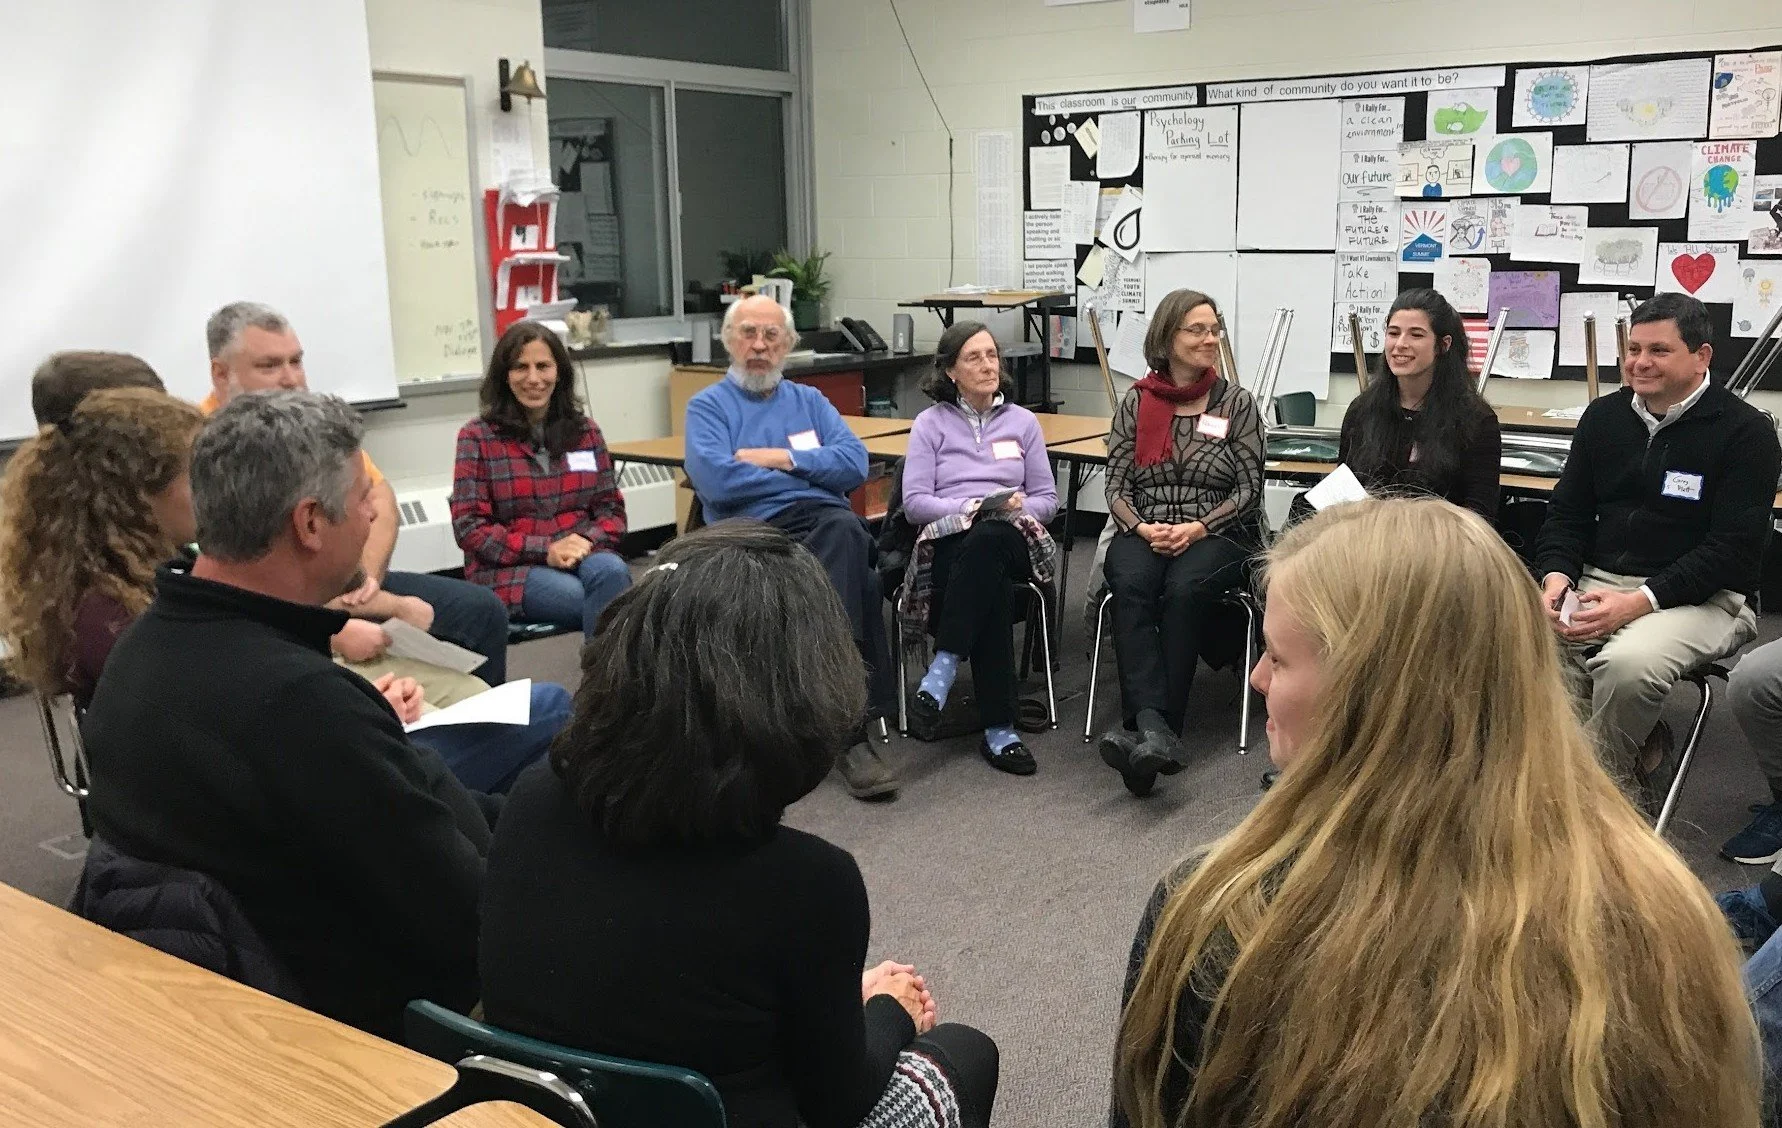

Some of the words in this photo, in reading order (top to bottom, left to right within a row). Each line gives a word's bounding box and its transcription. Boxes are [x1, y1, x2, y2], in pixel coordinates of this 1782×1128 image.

[1208, 89, 1234, 100] What
[1236, 87, 1257, 98] kind
[1263, 85, 1274, 95] of
[1279, 83, 1337, 96] community
[1340, 80, 1354, 91] do
[1357, 80, 1377, 92] you
[1381, 78, 1408, 89] want
[1411, 76, 1418, 87] it
[1421, 76, 1432, 86] to
[1437, 72, 1459, 84] be?
[1037, 101, 1055, 111] This
[1060, 97, 1106, 109] classroom
[1111, 96, 1119, 106] is
[1121, 97, 1137, 107] our
[1365, 104, 1378, 113] Rally
[1150, 111, 1205, 134] Psychology
[1346, 117, 1355, 125] a
[1361, 116, 1392, 125] clean
[1165, 130, 1201, 150] Parking
[1207, 130, 1229, 145] Lot
[1701, 143, 1750, 155] CLIMATE
[1364, 155, 1377, 164] Rally
[1708, 155, 1742, 164] CHANGE
[1363, 205, 1375, 214] Rally
[1344, 225, 1389, 235] FUTURE'S
[1349, 236, 1390, 246] FUTURE
[1342, 263, 1370, 279] Take
[1345, 281, 1387, 299] Action!
[1370, 331, 1380, 349] $
